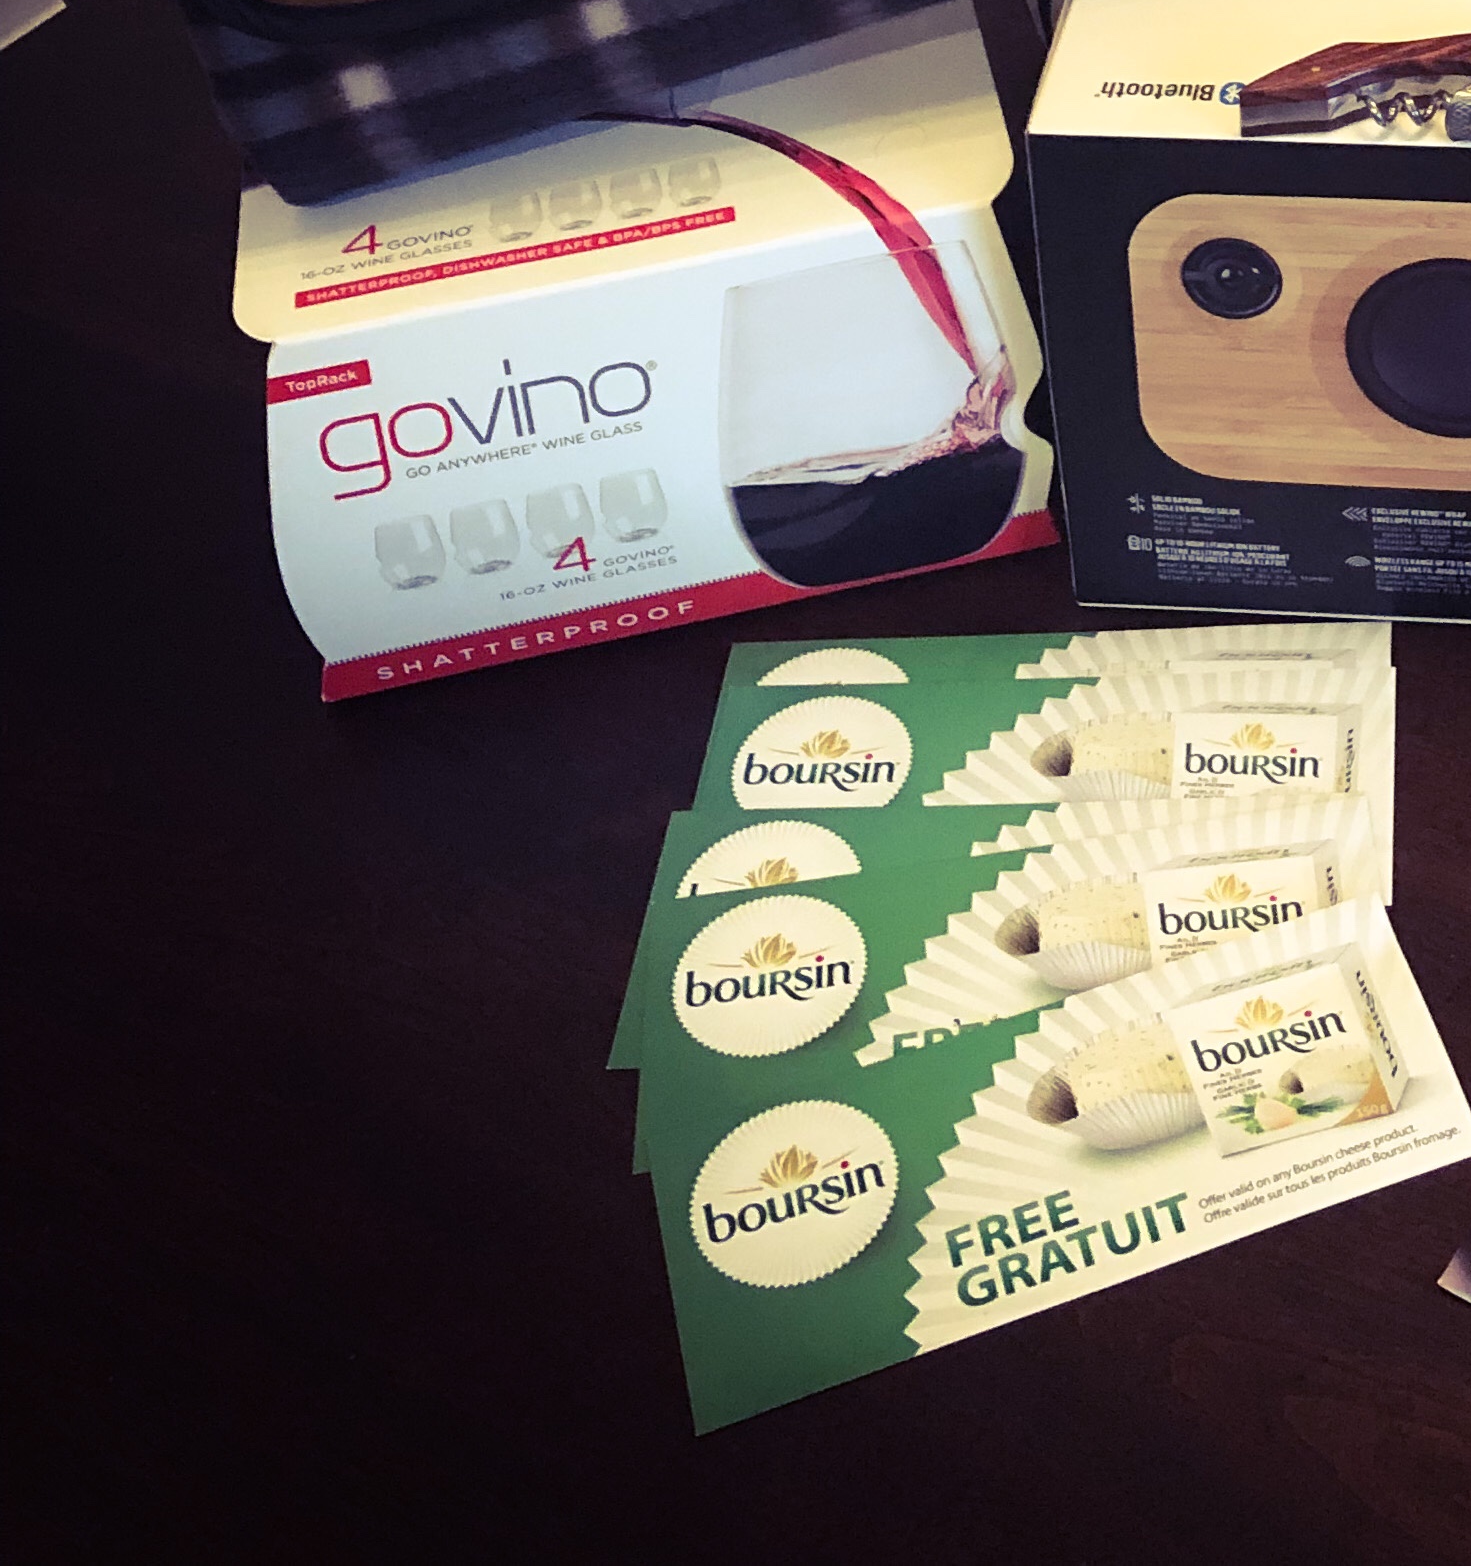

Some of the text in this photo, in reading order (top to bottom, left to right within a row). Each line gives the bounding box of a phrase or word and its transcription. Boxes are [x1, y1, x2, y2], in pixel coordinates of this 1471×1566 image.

[1100, 81, 1216, 101] Bluetooth
[301, 239, 473, 280] 16-OZ WINE GLASSES
[341, 224, 383, 255] 4
[442, 247, 548, 275] DISHWASHER
[552, 238, 593, 254] SAFE
[685, 212, 725, 227] FREE
[284, 368, 359, 394] TopRack
[405, 465, 431, 480] GO
[542, 433, 585, 451] WINE
[589, 421, 644, 443] GLASS
[499, 555, 678, 601] 16-OZ WINE GLASSES
[552, 536, 597, 572] 4
[376, 600, 695, 681] SHATTERPROOF
[1198, 1194, 1227, 1210] Offer
[1228, 1182, 1255, 1199] valid
[1256, 1177, 1272, 1189] on
[1272, 1170, 1293, 1186] any
[1293, 1154, 1335, 1175] Boursin
[1335, 1140, 1372, 1160] cheese
[1203, 1207, 1232, 1224] Offre
[1233, 1193, 1267, 1214] valide
[1267, 1190, 1285, 1202] sur
[1285, 1180, 1311, 1195] tous
[1311, 1173, 1327, 1186] les
[1327, 1156, 1373, 1182] produits
[1372, 1142, 1414, 1163] Boursin
[945, 1190, 1080, 1268] FREE
[957, 1192, 1187, 1307] GRATUIT
